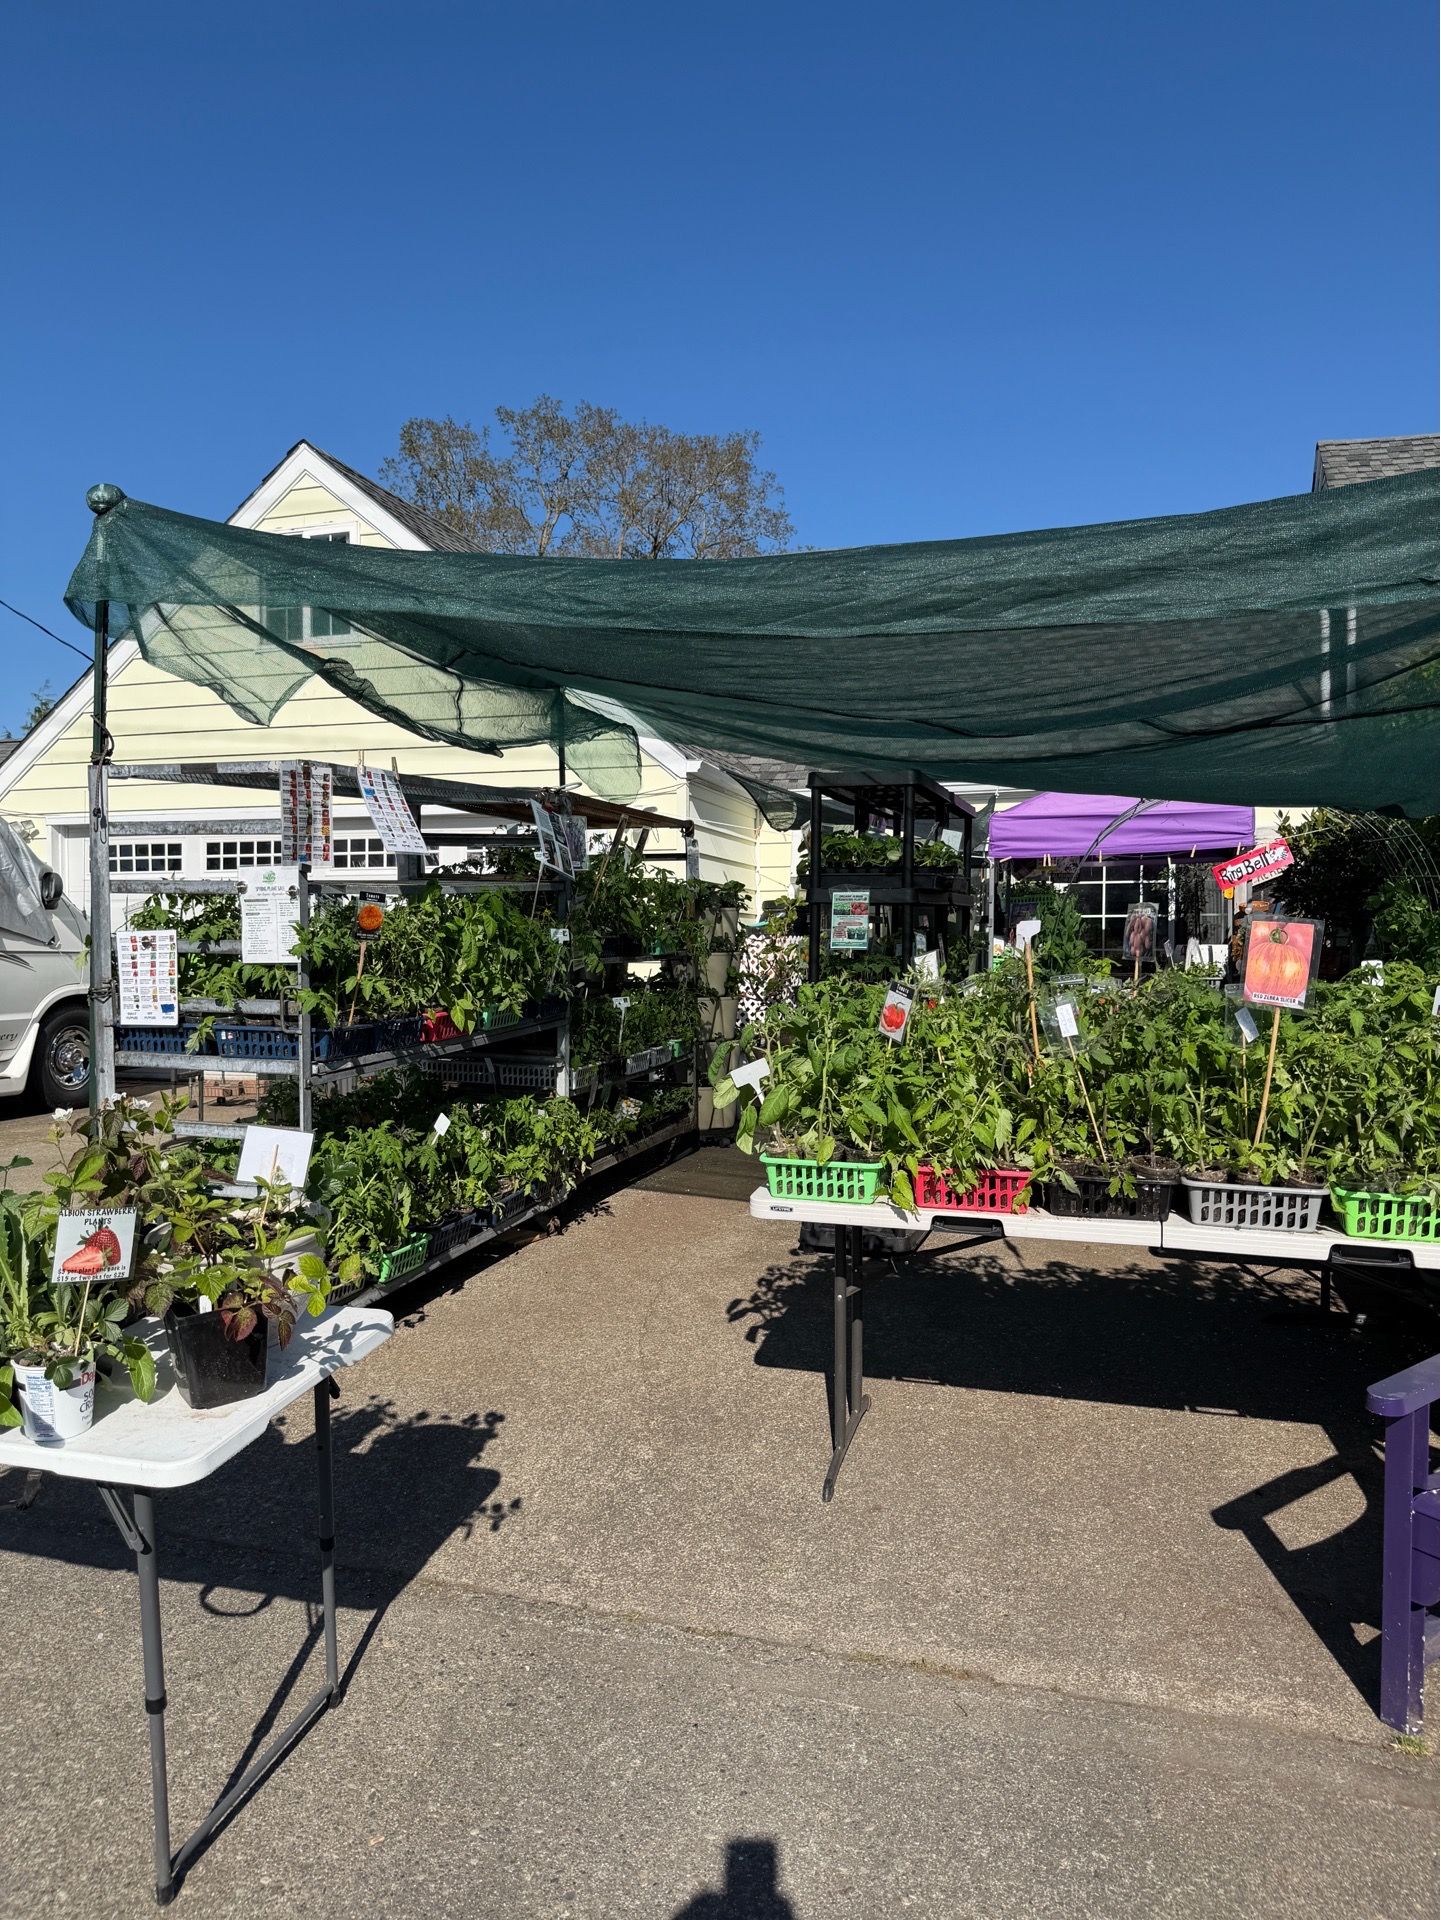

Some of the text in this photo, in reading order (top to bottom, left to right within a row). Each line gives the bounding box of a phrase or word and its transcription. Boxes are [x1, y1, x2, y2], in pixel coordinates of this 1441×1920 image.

[1218, 866, 1243, 884] Ring
[1242, 852, 1270, 875] Bell
[59, 1207, 136, 1217] ALBION STRAWBERRY
[84, 1218, 112, 1226] PLANTS
[84, 1388, 94, 1403] SO
